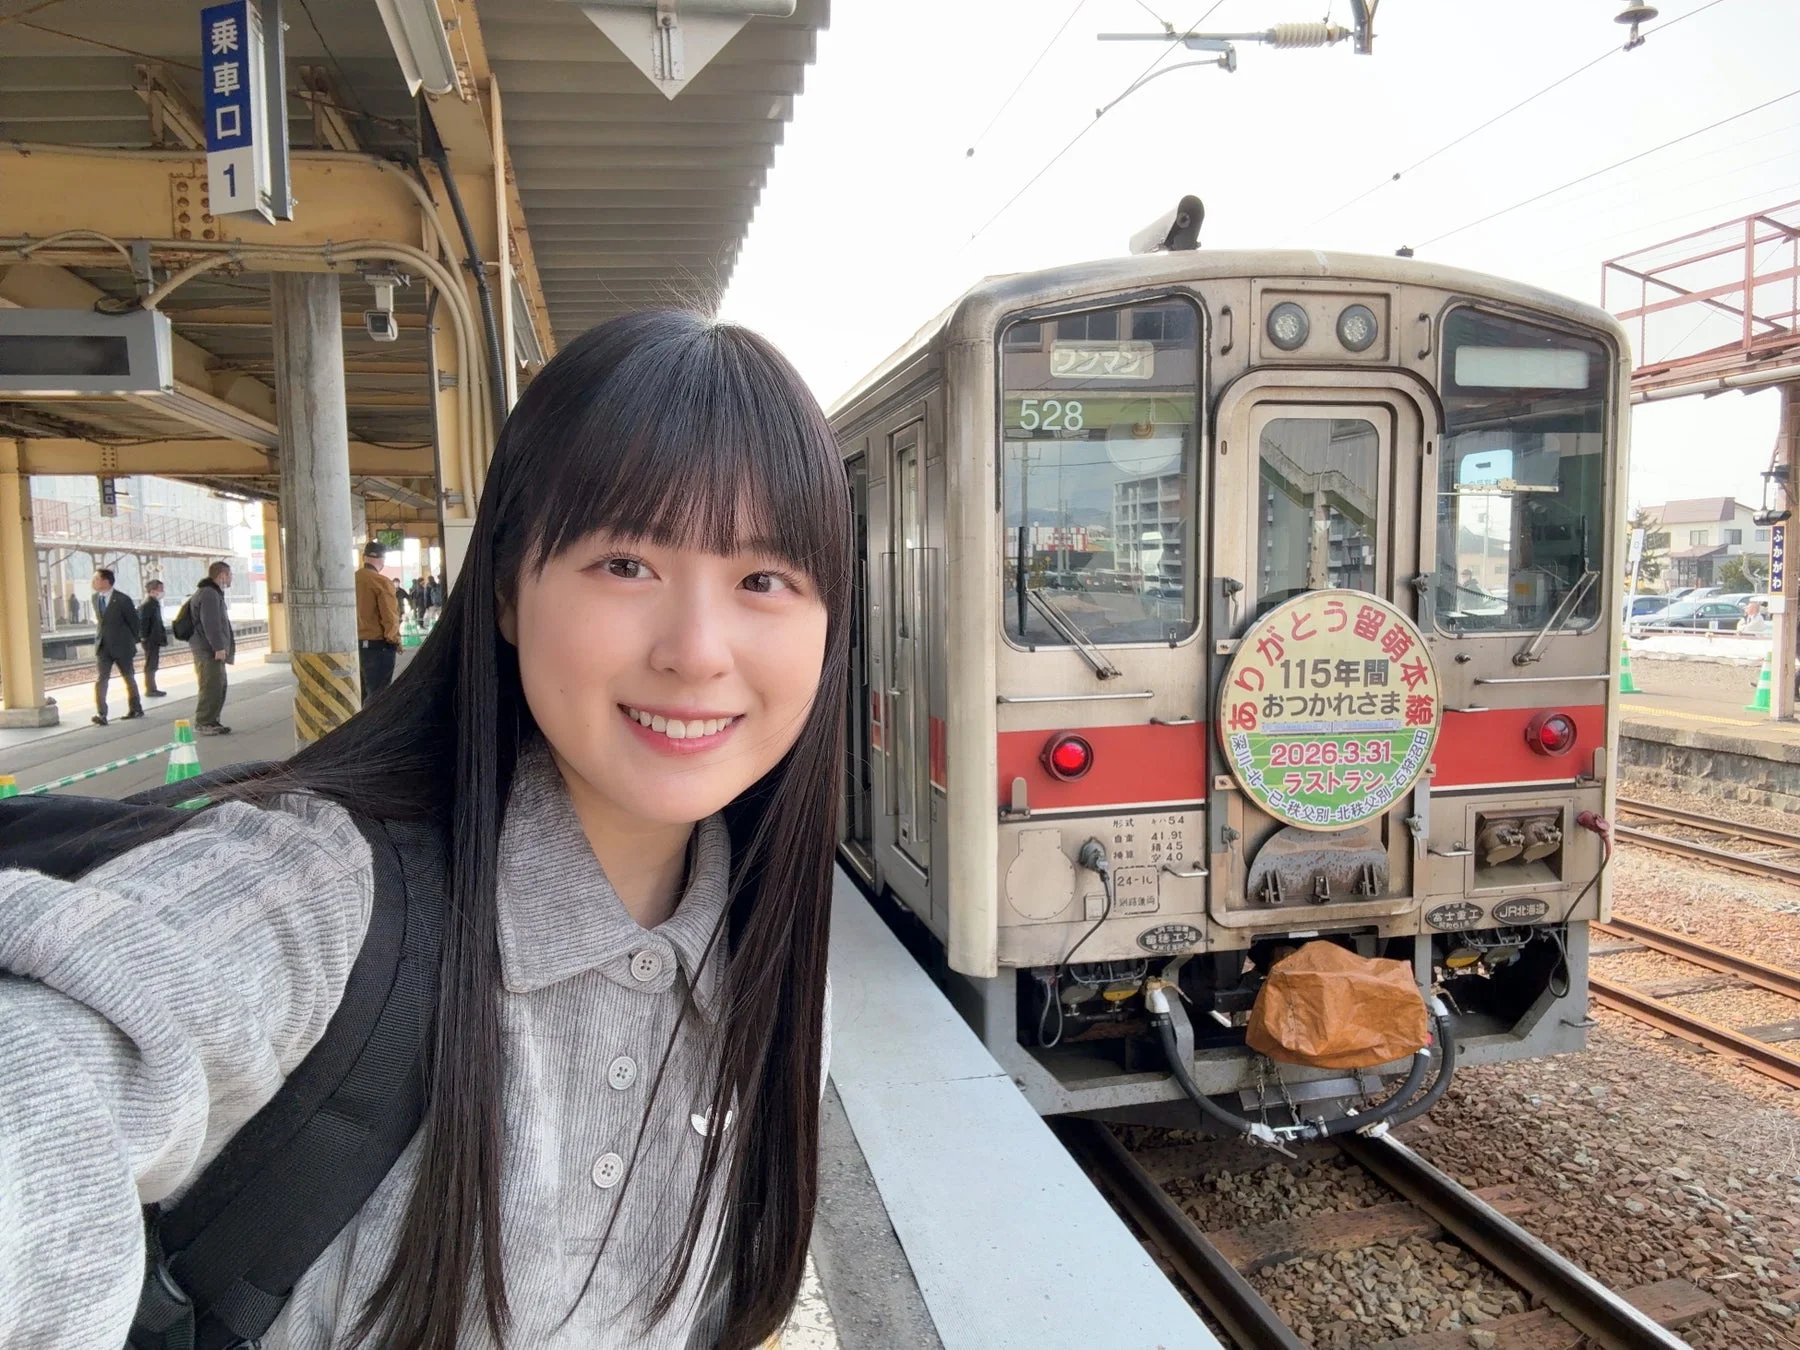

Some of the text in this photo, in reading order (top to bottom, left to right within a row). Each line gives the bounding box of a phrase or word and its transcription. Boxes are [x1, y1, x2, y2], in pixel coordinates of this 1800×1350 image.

[210, 17, 243, 141] 乗車口
[222, 163, 237, 198] 1
[1054, 348, 1144, 375] ワンマン
[1019, 399, 1083, 432] 528
[1772, 529, 1784, 589] ふかがわ
[1228, 600, 1435, 731] ありがとう留萌本線
[1280, 659, 1390, 689] 115年間
[1262, 691, 1401, 719] おつかれさま
[1270, 741, 1391, 767] 2026.3.31
[1284, 771, 1383, 795] ラストラン
[1432, 909, 1480, 923] 富士重工
[1499, 903, 1546, 918] JR北海道
